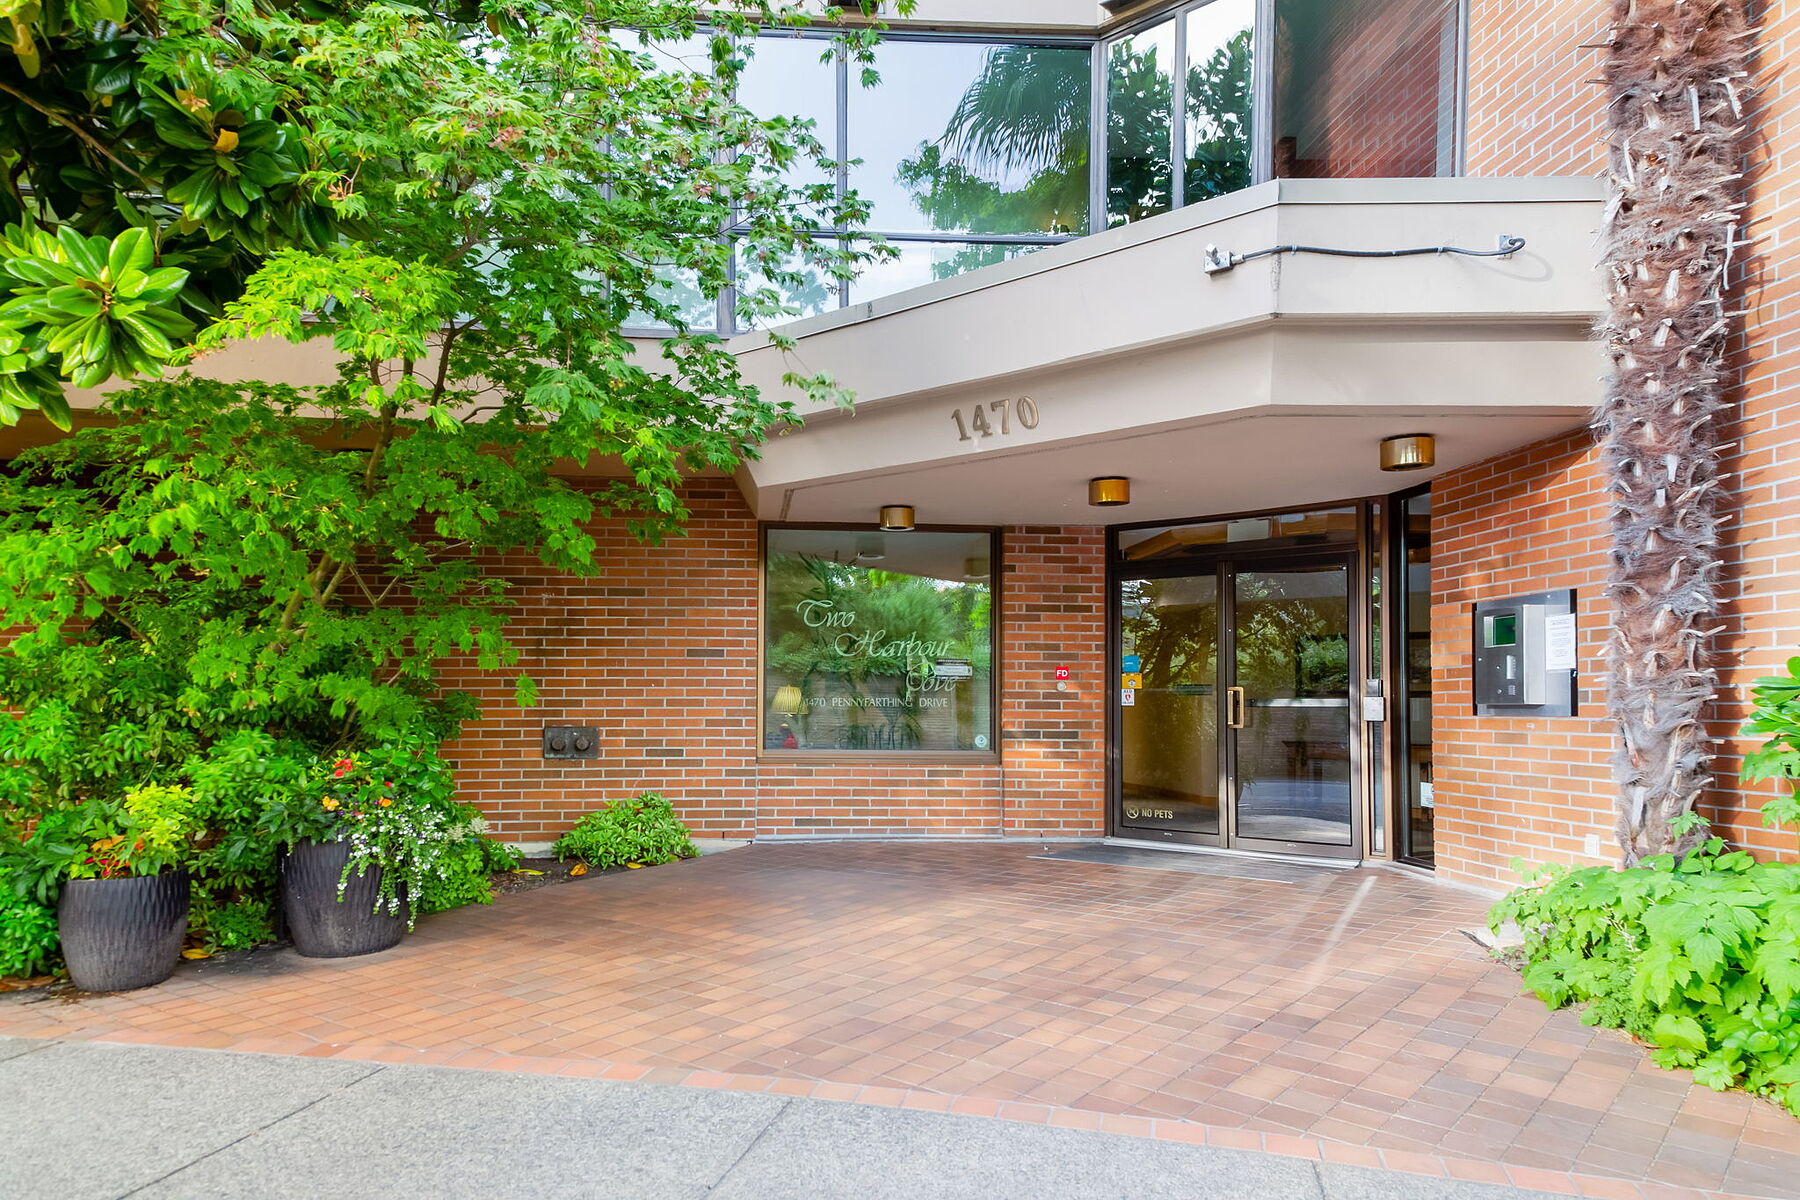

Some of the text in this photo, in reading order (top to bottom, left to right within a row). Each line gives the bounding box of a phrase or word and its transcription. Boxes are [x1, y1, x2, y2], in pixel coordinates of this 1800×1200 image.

[951, 396, 1039, 441] 1470
[796, 599, 855, 627] Two
[834, 630, 953, 657] Harbour
[906, 662, 957, 691] Cove
[1056, 669, 1068, 677] FD
[832, 697, 913, 708] PENNYFARTHING
[919, 698, 948, 708] DRIVE
[1141, 808, 1173, 819] NO PETS
